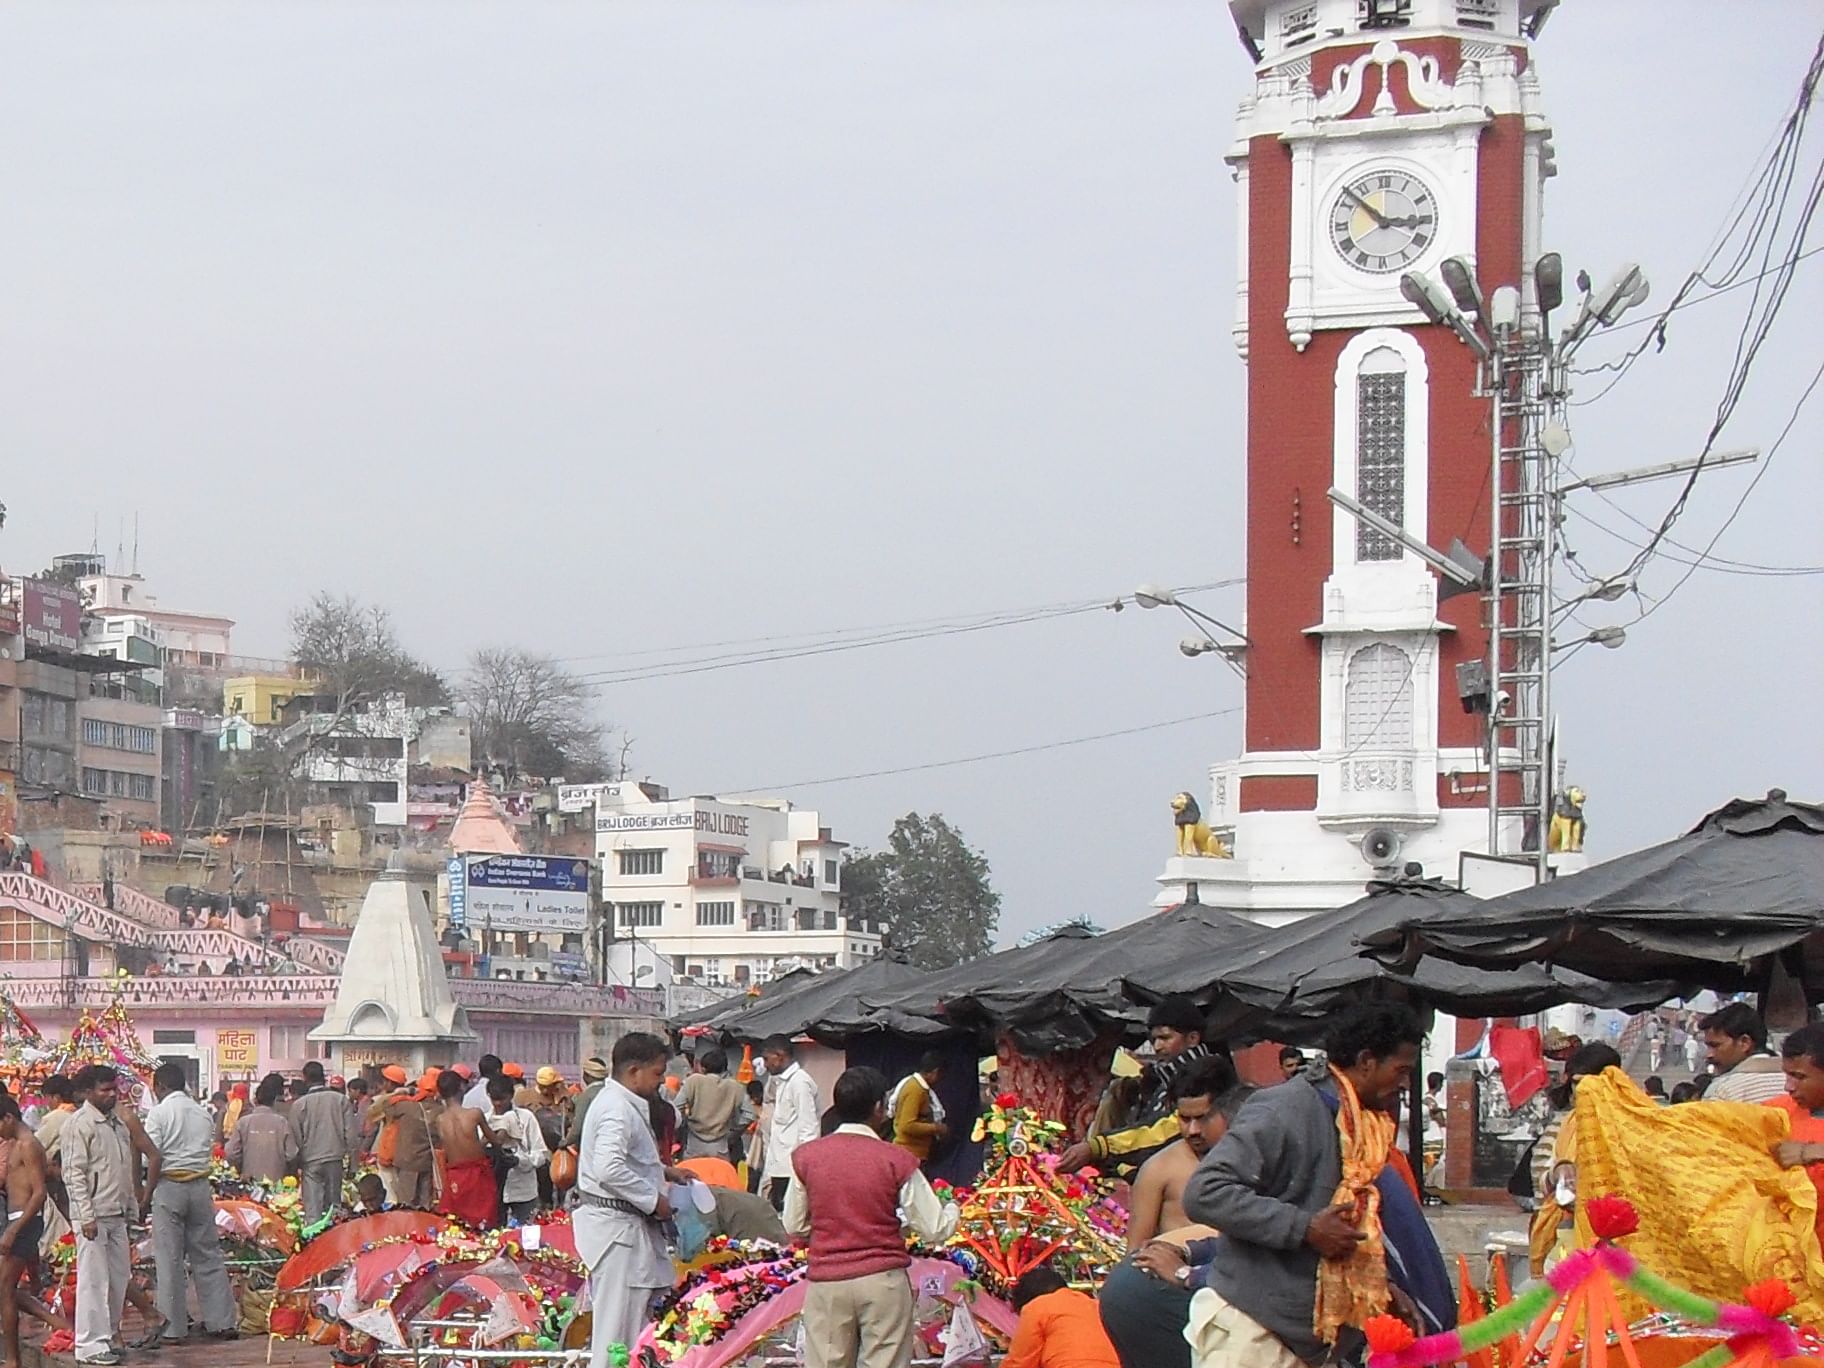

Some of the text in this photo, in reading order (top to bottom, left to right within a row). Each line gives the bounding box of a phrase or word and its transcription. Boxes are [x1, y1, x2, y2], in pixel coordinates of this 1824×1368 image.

[597, 815, 648, 829] BRIJ LODGE
[695, 810, 749, 837] BRIJ LODGE
[537, 904, 562, 914] Ladies
[218, 1030, 256, 1048] महिला
[224, 1049, 249, 1061] घाट
